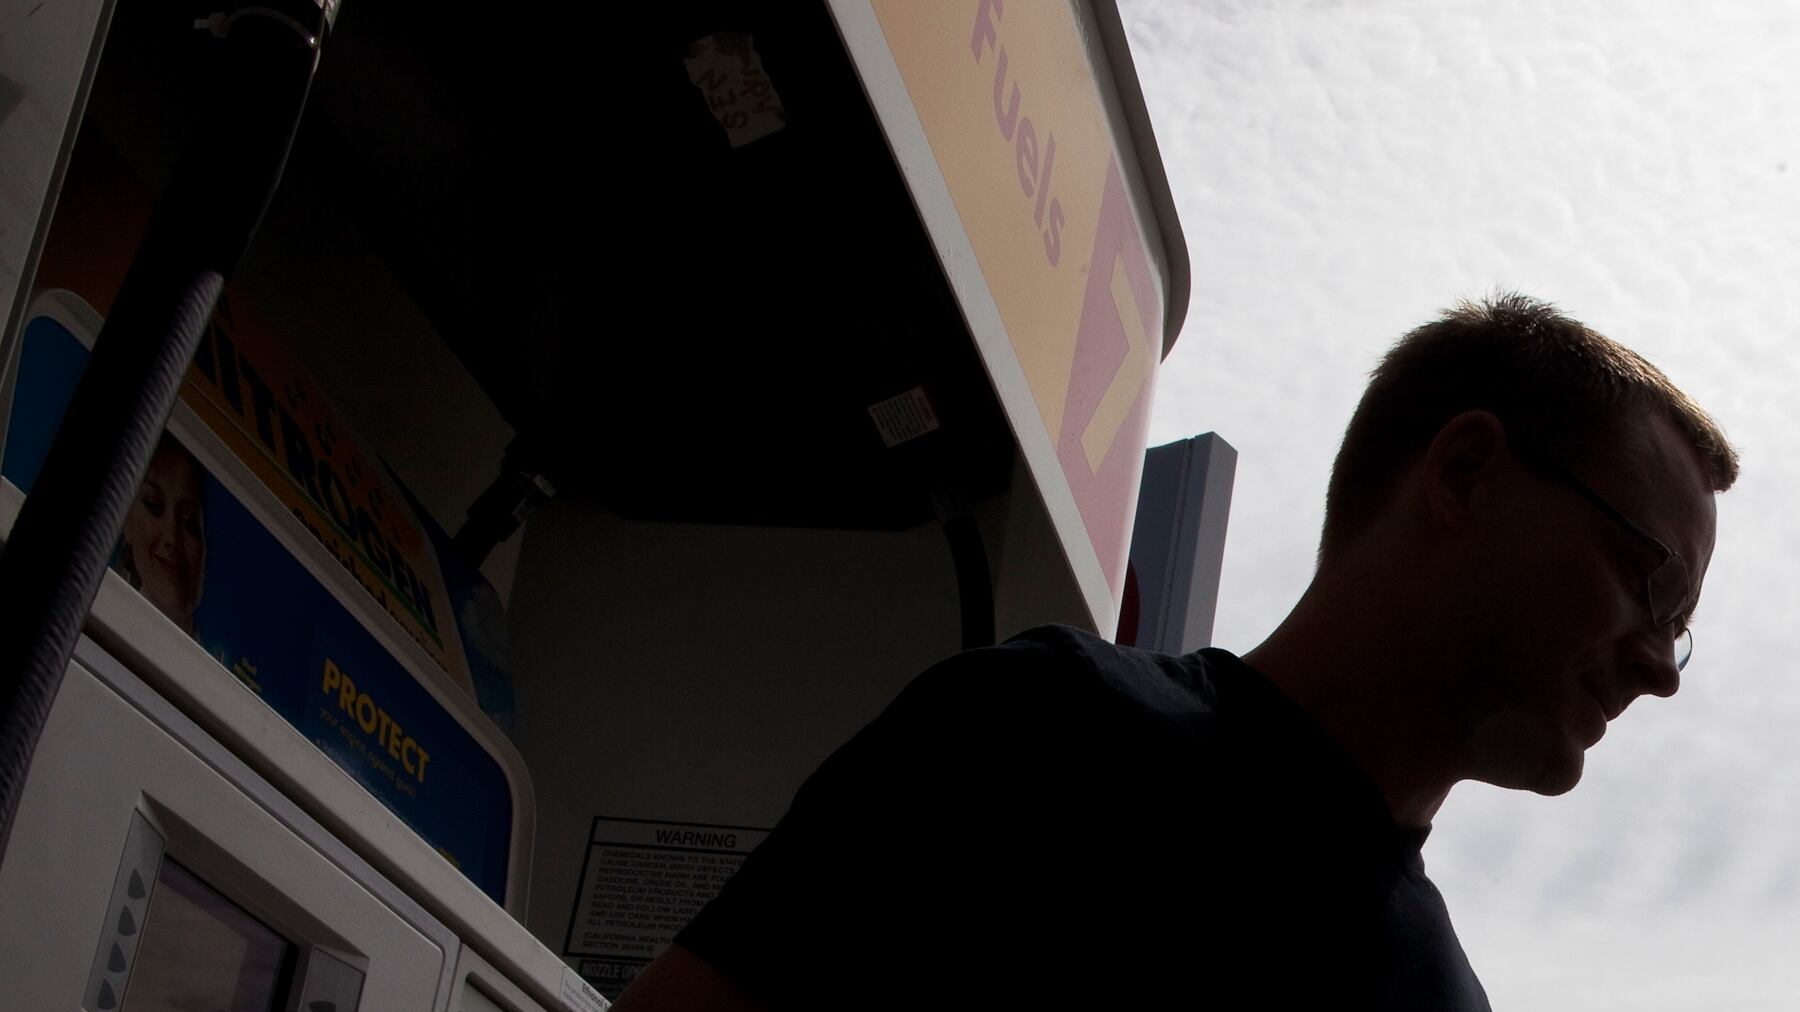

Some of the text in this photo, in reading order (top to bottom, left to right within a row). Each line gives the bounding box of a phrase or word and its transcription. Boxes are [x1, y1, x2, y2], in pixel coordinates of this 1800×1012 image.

[971, 0, 1066, 267] Fuels
[322, 656, 431, 785] PROTECT
[656, 829, 737, 848] WARNING
[654, 854, 685, 863] KNOWN
[688, 856, 698, 864] TO
[702, 857, 716, 865] THE
[636, 905, 671, 914] FOLLOW
